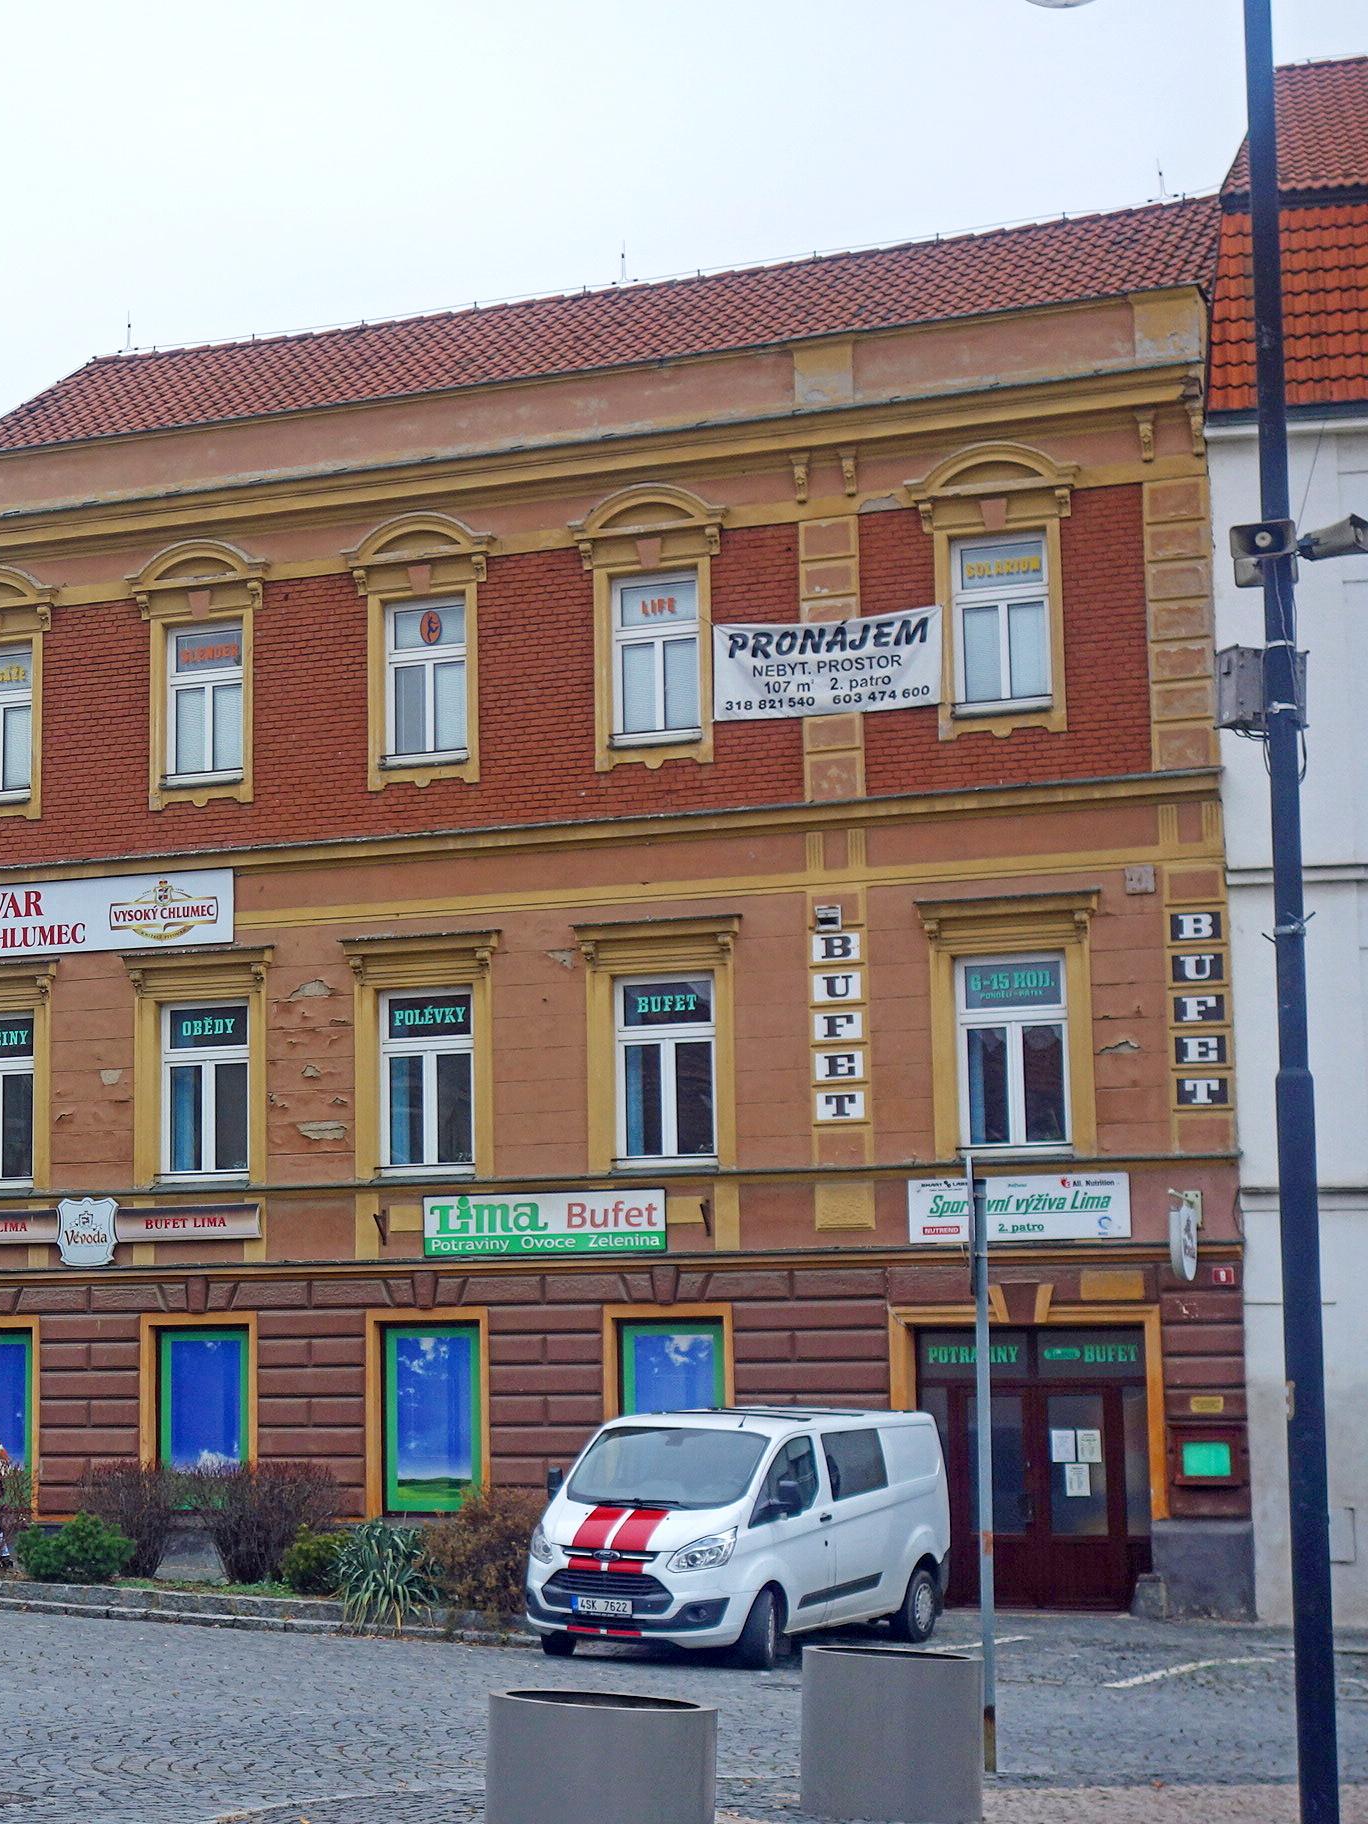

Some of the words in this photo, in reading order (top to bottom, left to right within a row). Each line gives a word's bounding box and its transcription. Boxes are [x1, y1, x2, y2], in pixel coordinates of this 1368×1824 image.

[728, 616, 930, 659] PRONÁJEM
[753, 662, 811, 677] NEBYT.
[817, 655, 902, 674] PROSTOR
[764, 681, 791, 694] 107
[830, 678, 844, 691] 2.
[849, 675, 892, 692] patro
[725, 700, 753, 711] 318
[758, 698, 783, 710] 821
[789, 696, 815, 708] 540
[832, 693, 862, 705] 603
[868, 690, 897, 701] 474
[902, 685, 930, 698] 600
[114, 905, 158, 922] VYSOKÝ
[160, 904, 215, 919] CHLUMEC
[637, 994, 697, 1013] BUFET
[1178, 913, 1220, 1104] BUFET
[394, 1005, 466, 1026] POLÉVKY
[182, 1016, 235, 1036] OBĚDY
[821, 935, 856, 1117] BUFET
[929, 1195, 1013, 1218] Sporvní
[1015, 1193, 1067, 1215] výživa
[1071, 1190, 1112, 1209] Lima
[145, 1218, 188, 1229] BUFET
[193, 1216, 227, 1228] LIMA
[430, 1196, 549, 1235] Lima
[567, 1200, 658, 1229] Bufet
[998, 1223, 1008, 1232] 2.
[1012, 1223, 1045, 1234] patro
[432, 1238, 510, 1253] Potraviny
[521, 1235, 576, 1249] Ovoce
[588, 1234, 660, 1248] Zelenina
[928, 1346, 1019, 1364] POTRAINY
[1084, 1344, 1137, 1363] BUFET
[580, 1599, 597, 1610] 4SK
[604, 1601, 627, 1612] 7622
